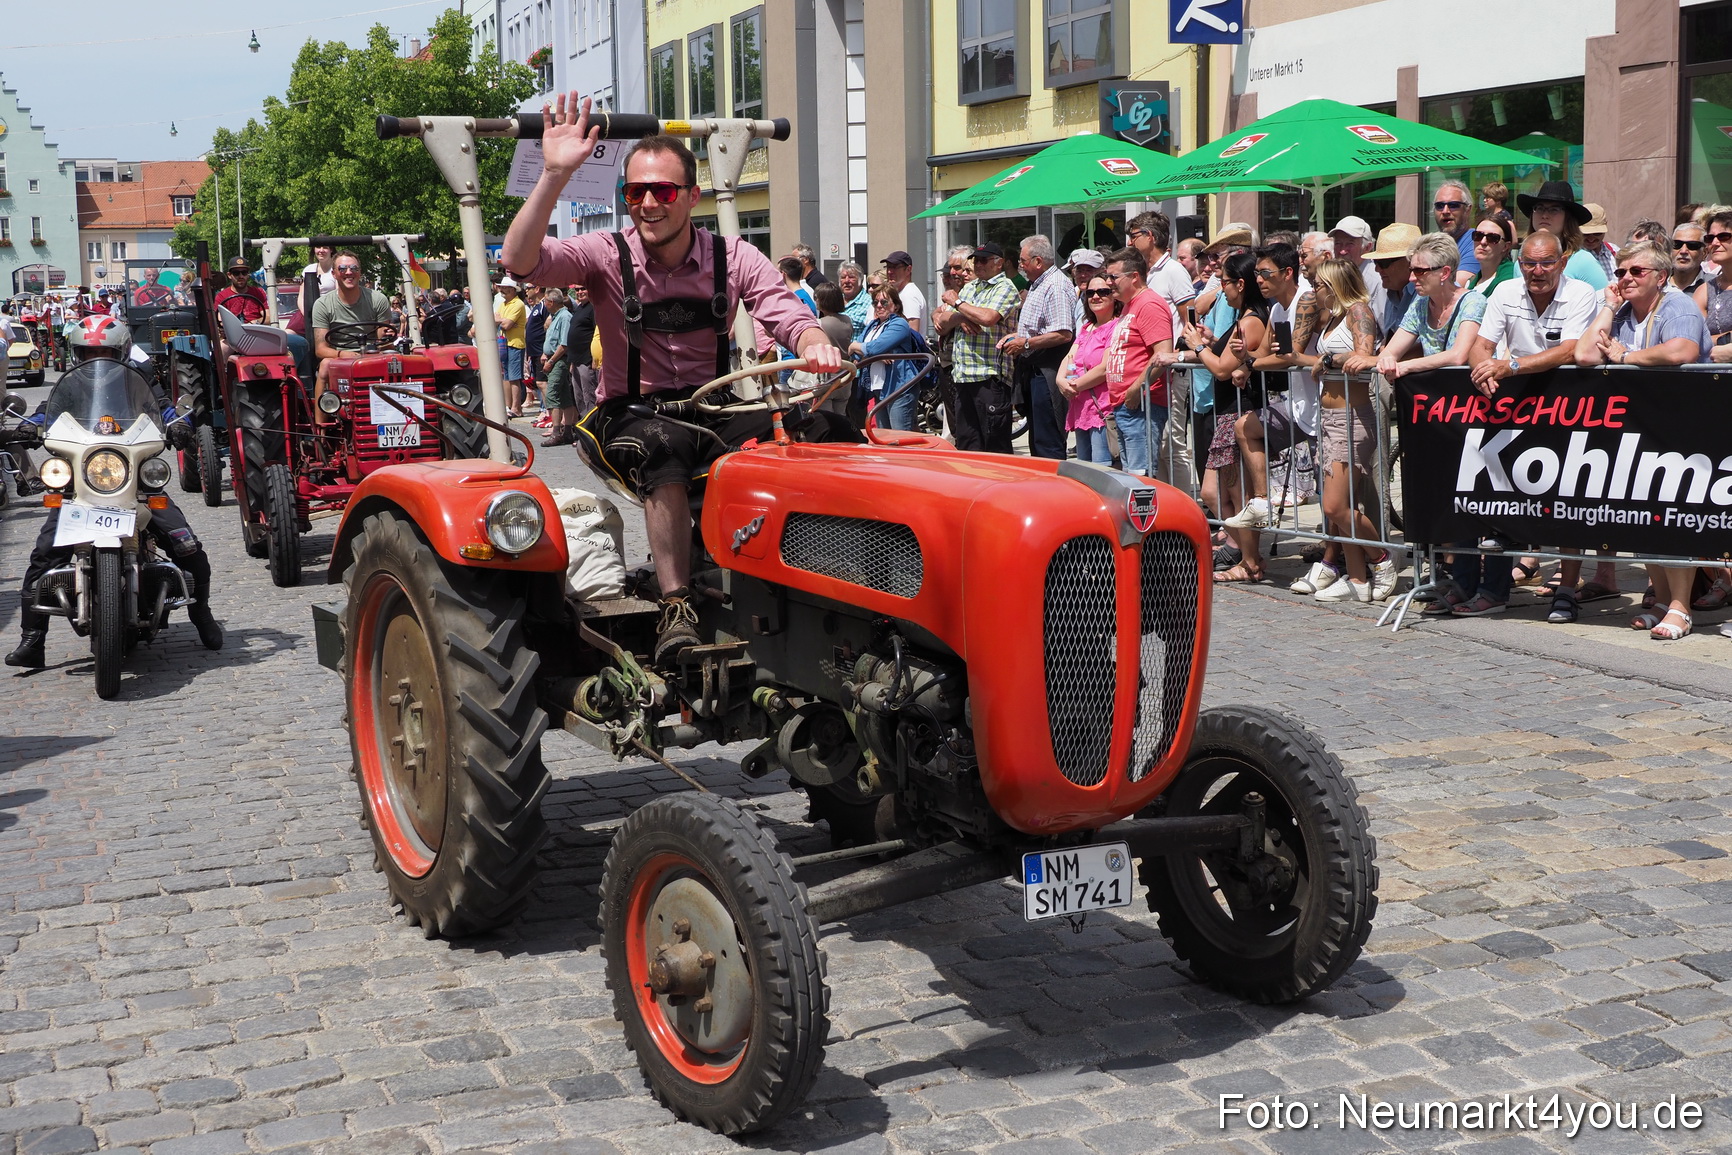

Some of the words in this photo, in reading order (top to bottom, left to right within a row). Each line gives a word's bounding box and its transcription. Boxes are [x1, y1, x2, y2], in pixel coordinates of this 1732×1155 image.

[1249, 67, 1273, 81] Unterer
[1274, 62, 1293, 77] Markt
[1295, 58, 1303, 73] 15
[1129, 101, 1153, 132] G2
[1351, 152, 1469, 166] Lammsbräu
[1356, 145, 1439, 156] Neumarkter
[1412, 394, 1629, 429] FAHRSCHULE
[385, 426, 400, 436] NM
[382, 436, 396, 447] JT
[397, 435, 417, 446] 296
[1454, 496, 1543, 518] Neumarkt
[1553, 501, 1651, 526] Burgthann
[95, 515, 120, 529] 401
[1030, 873, 1038, 882] D
[1045, 853, 1080, 884] NM
[1035, 886, 1068, 915] SM
[1075, 879, 1122, 909] 741
